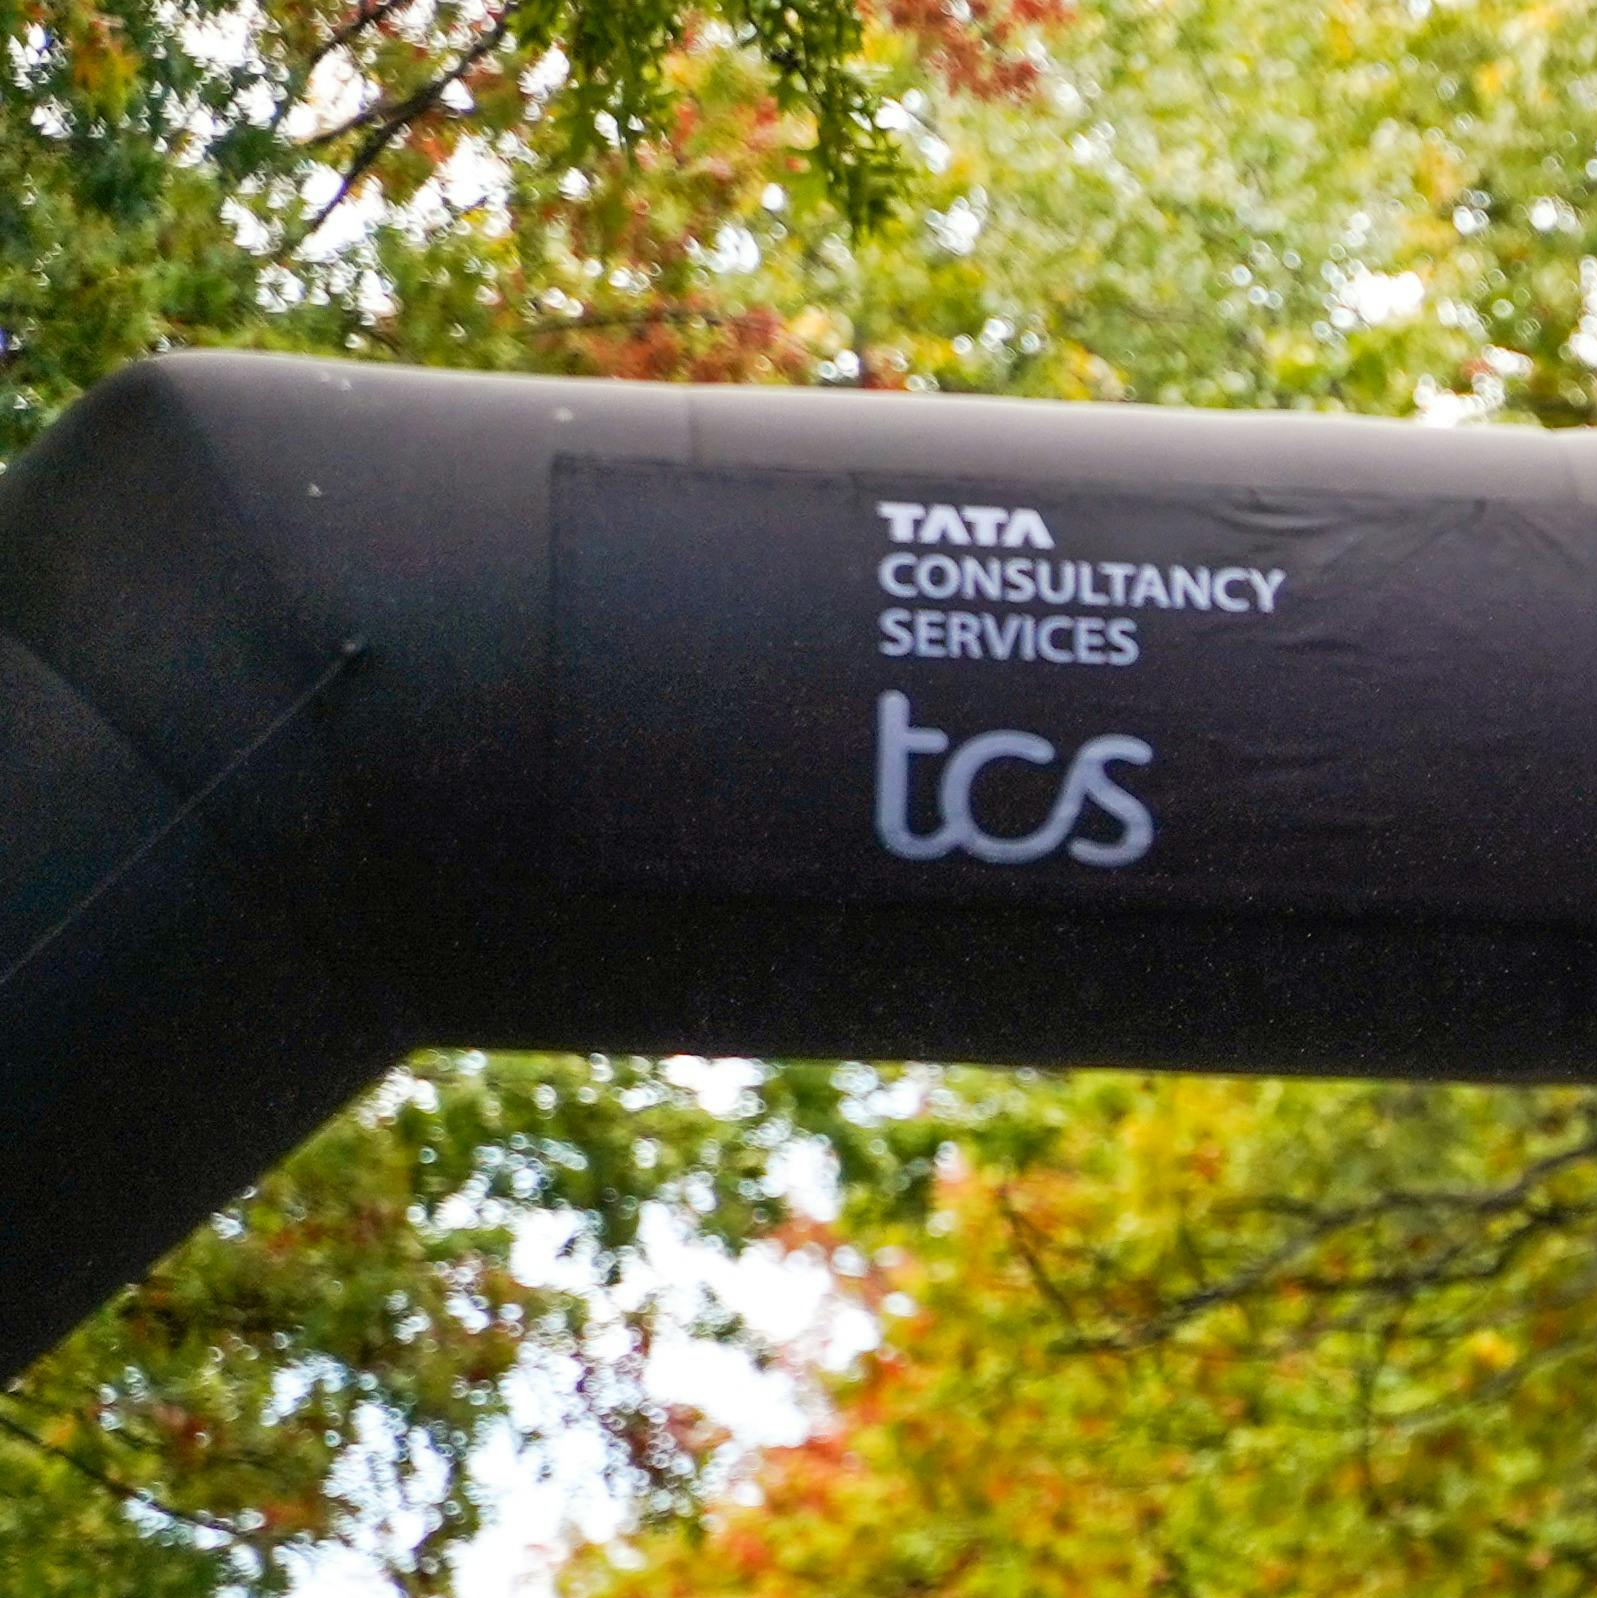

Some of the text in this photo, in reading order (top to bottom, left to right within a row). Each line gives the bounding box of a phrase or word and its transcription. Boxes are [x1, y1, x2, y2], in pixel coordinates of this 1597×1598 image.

[876, 501, 1055, 549] TATA
[877, 552, 1287, 613] CONSULTANCY
[877, 607, 1140, 666] SERVICES
[875, 689, 1154, 867] tcs
